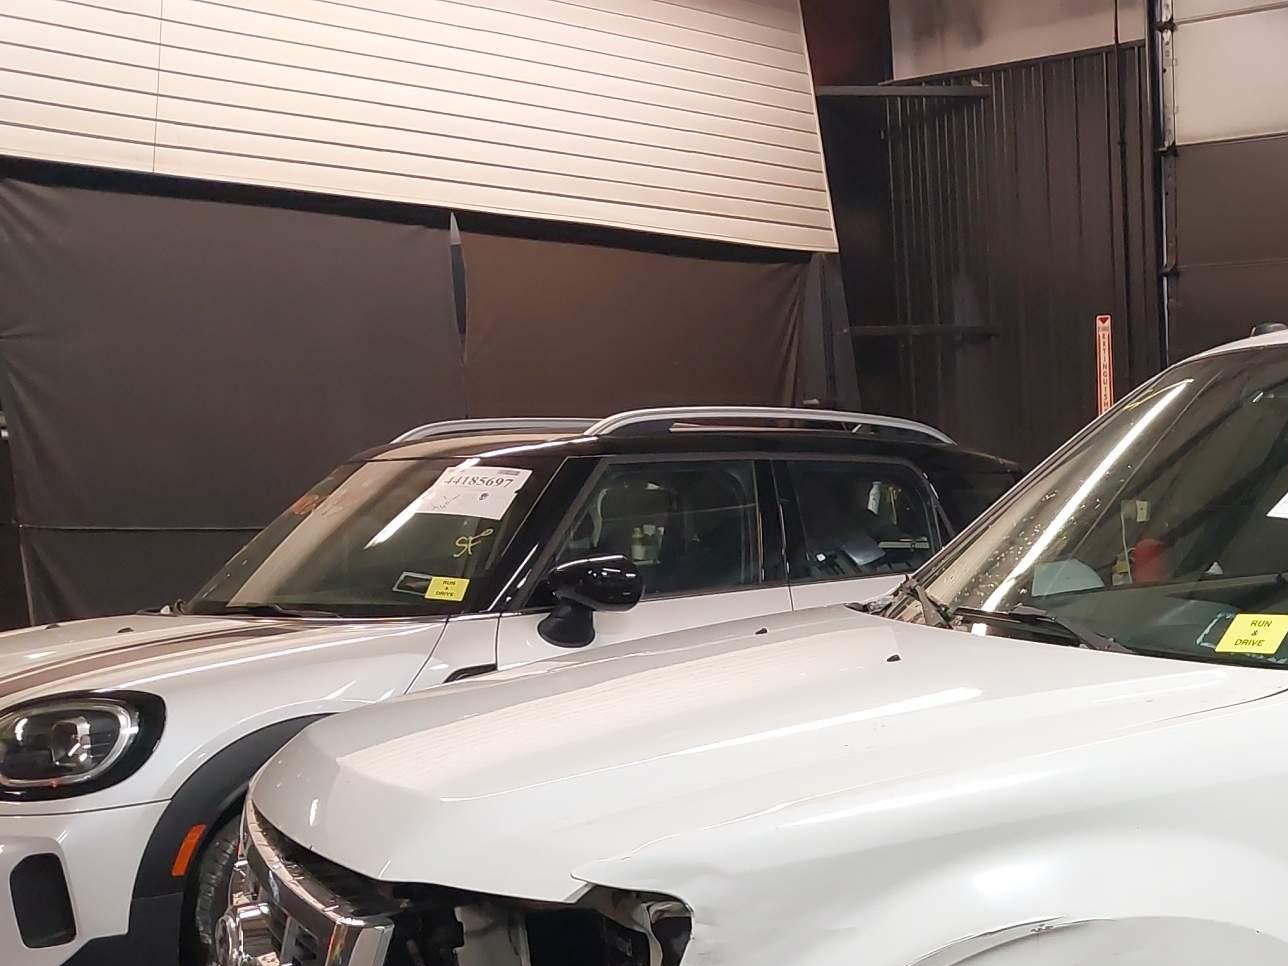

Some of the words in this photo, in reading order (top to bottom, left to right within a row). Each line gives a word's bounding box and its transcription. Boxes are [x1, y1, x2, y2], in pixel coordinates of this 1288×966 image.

[444, 474, 514, 489] 44185697
[1250, 619, 1273, 628] RUN
[1234, 638, 1265, 647] DRIVE
